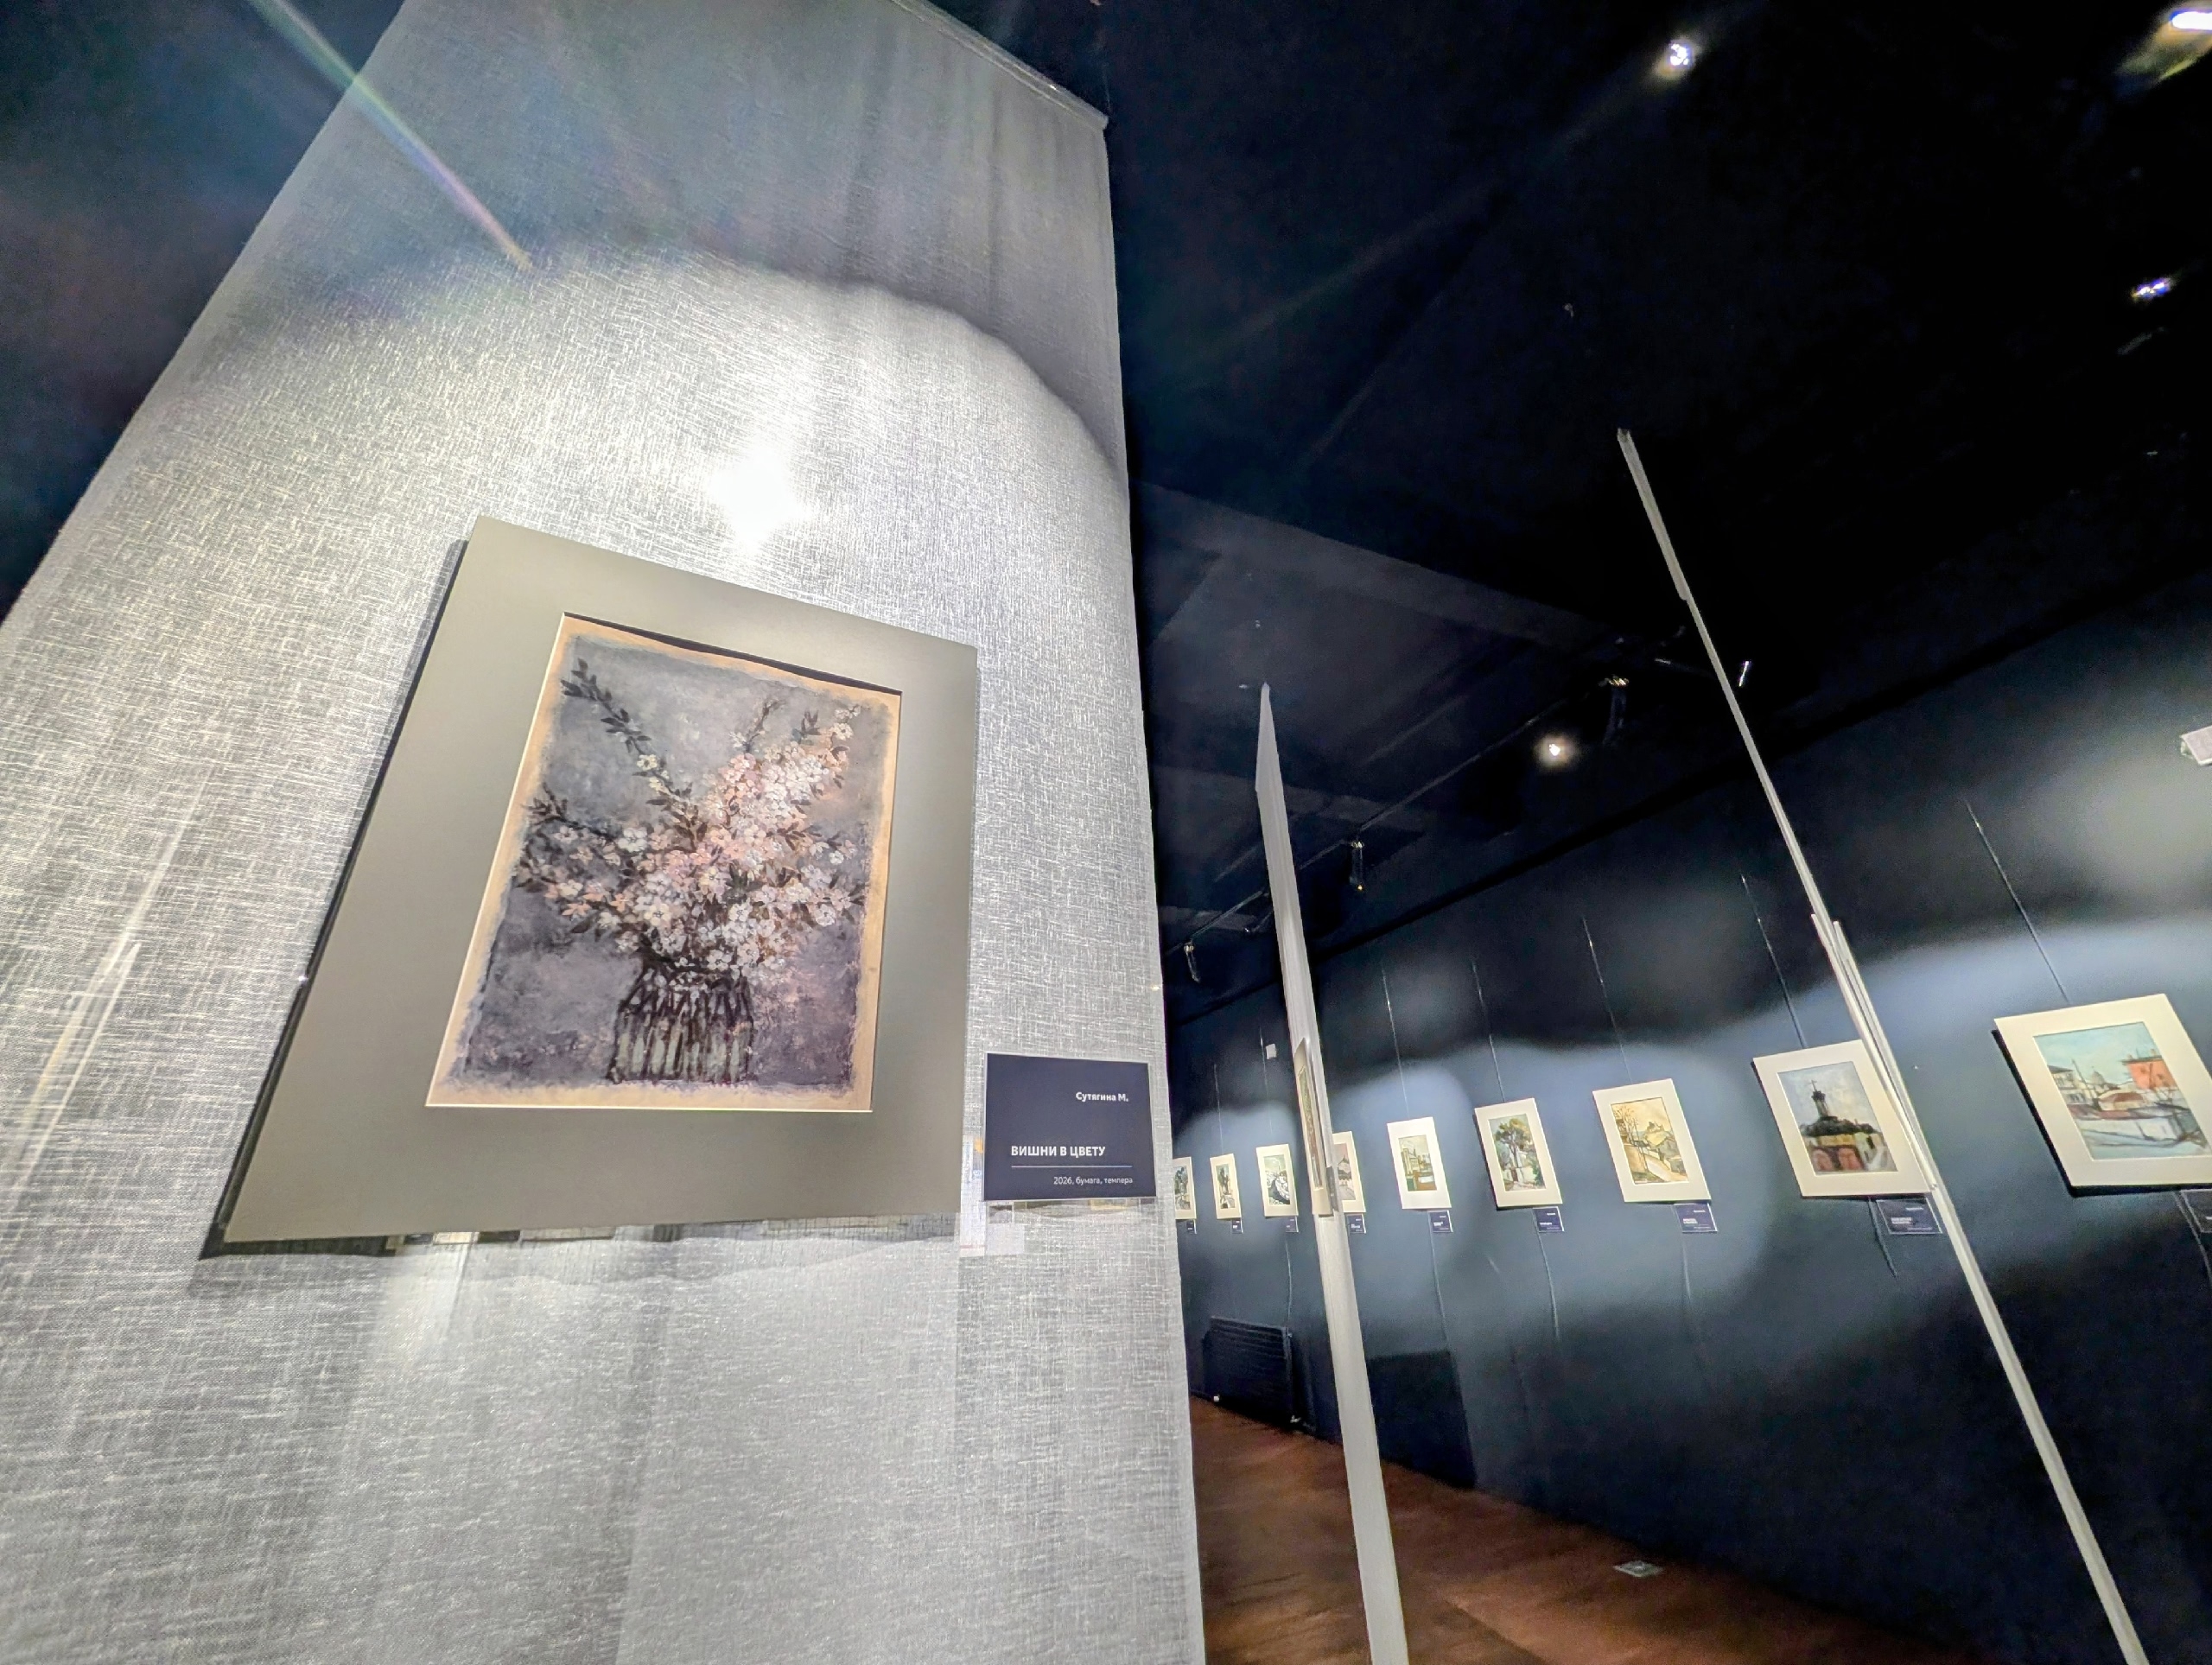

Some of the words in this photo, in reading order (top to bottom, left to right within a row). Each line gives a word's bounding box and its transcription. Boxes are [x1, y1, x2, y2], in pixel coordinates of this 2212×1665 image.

[1075, 1091, 1116, 1103] Сутягина
[1117, 1093, 1129, 1103] М.
[1011, 1146, 1057, 1157] ВИШНИ
[1059, 1146, 1067, 1157] В
[1070, 1146, 1106, 1159] ЦВЕТУ
[1053, 1176, 1074, 1185] 2026,
[1075, 1176, 1103, 1186] бумага,
[1103, 1177, 1133, 1185] темпера
